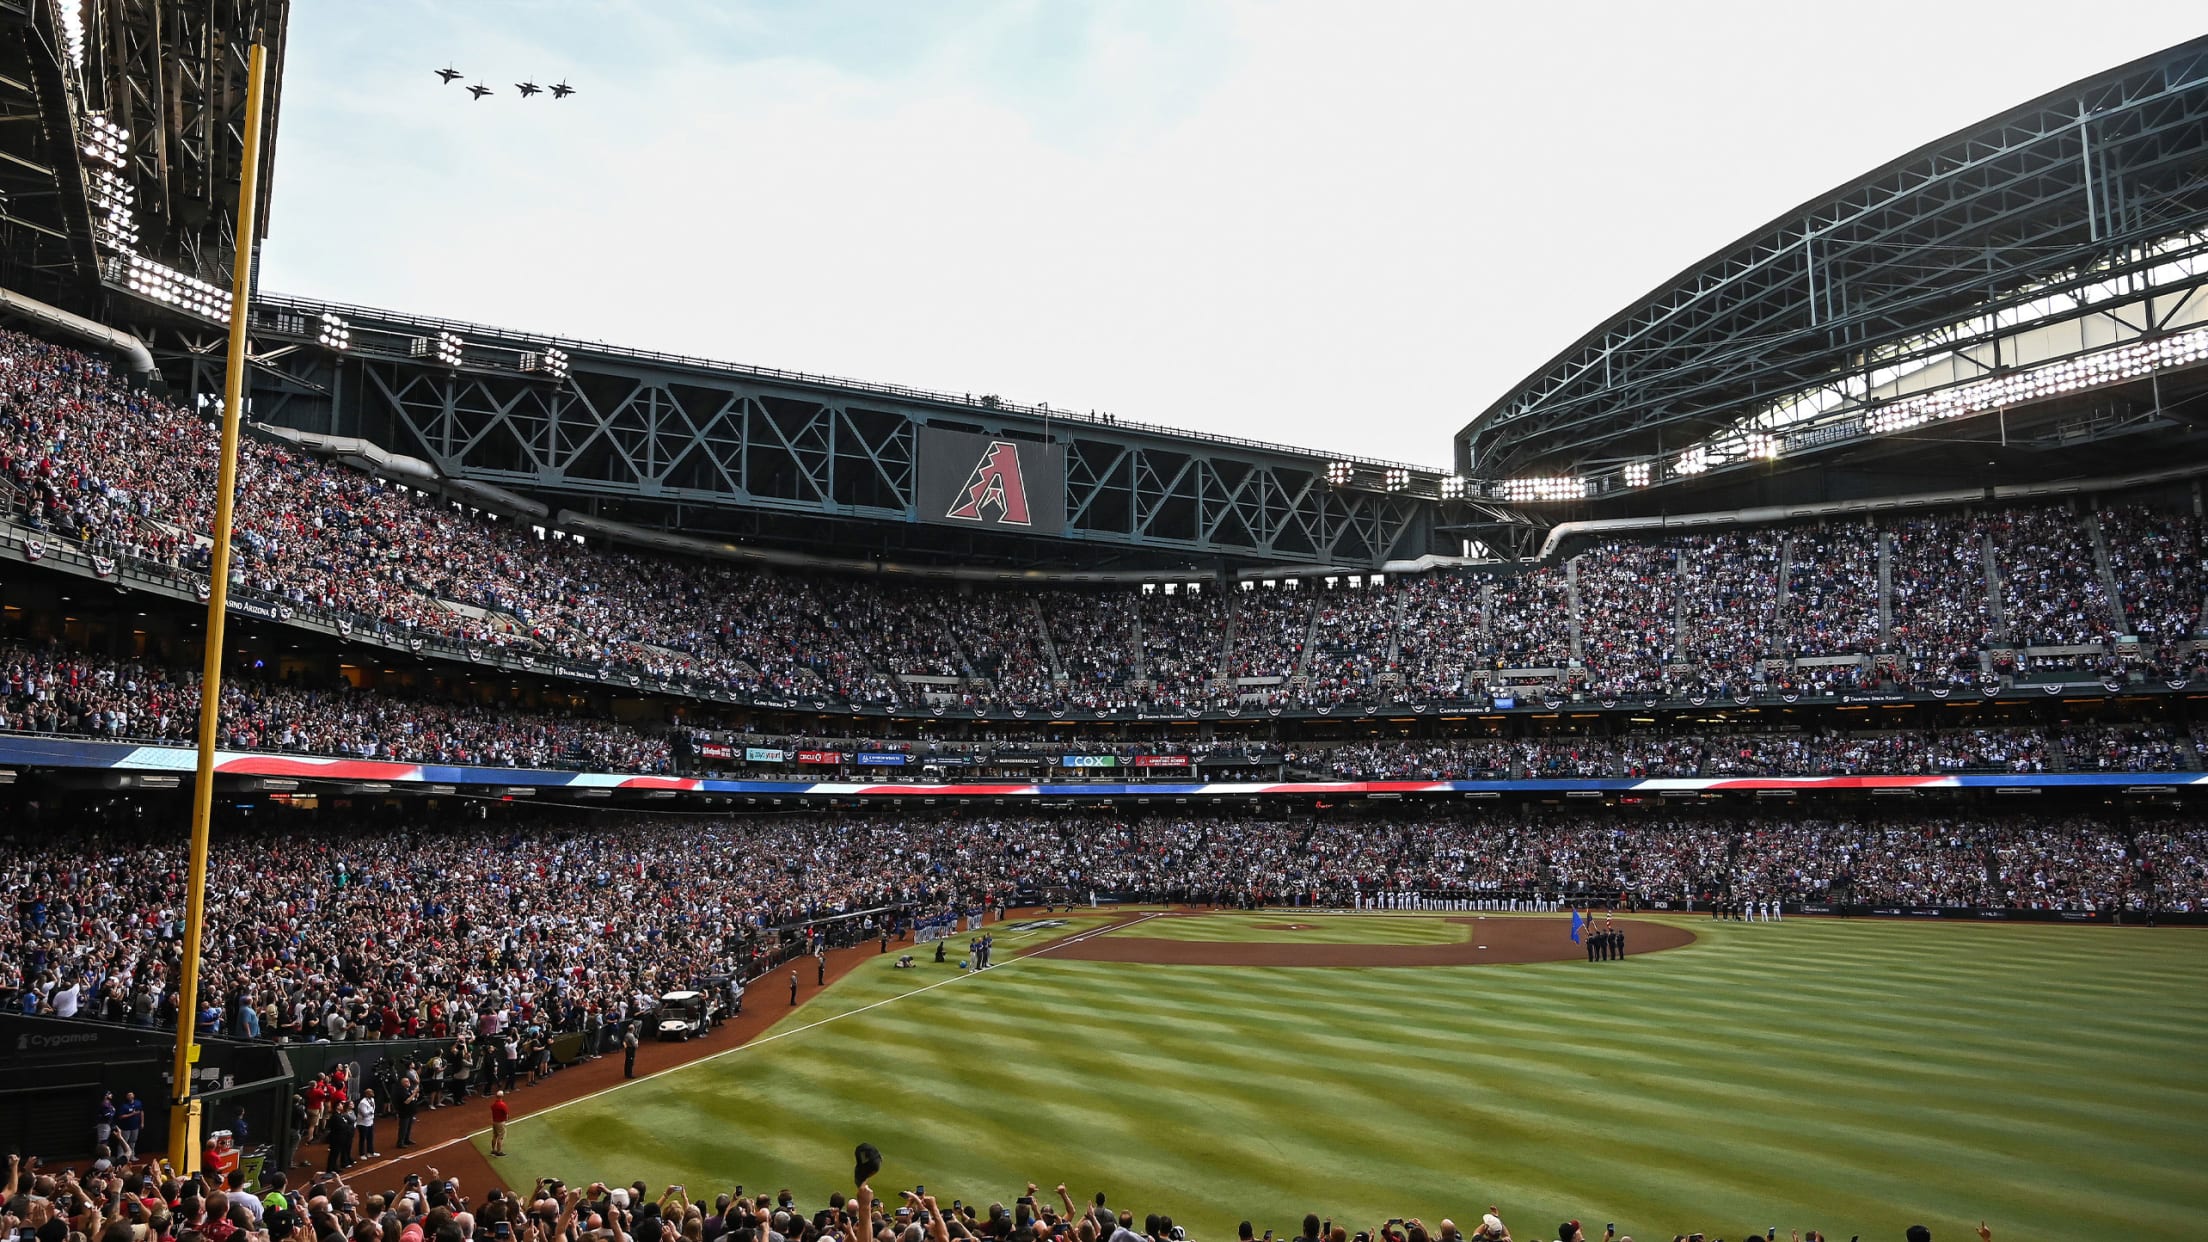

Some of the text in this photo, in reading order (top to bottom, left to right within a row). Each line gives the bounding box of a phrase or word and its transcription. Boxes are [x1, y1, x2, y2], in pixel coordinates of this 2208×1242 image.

[225, 600, 270, 616] ASINO ARIZONA
[1074, 756, 1104, 766] COX
[31, 1032, 98, 1047] Cygames
